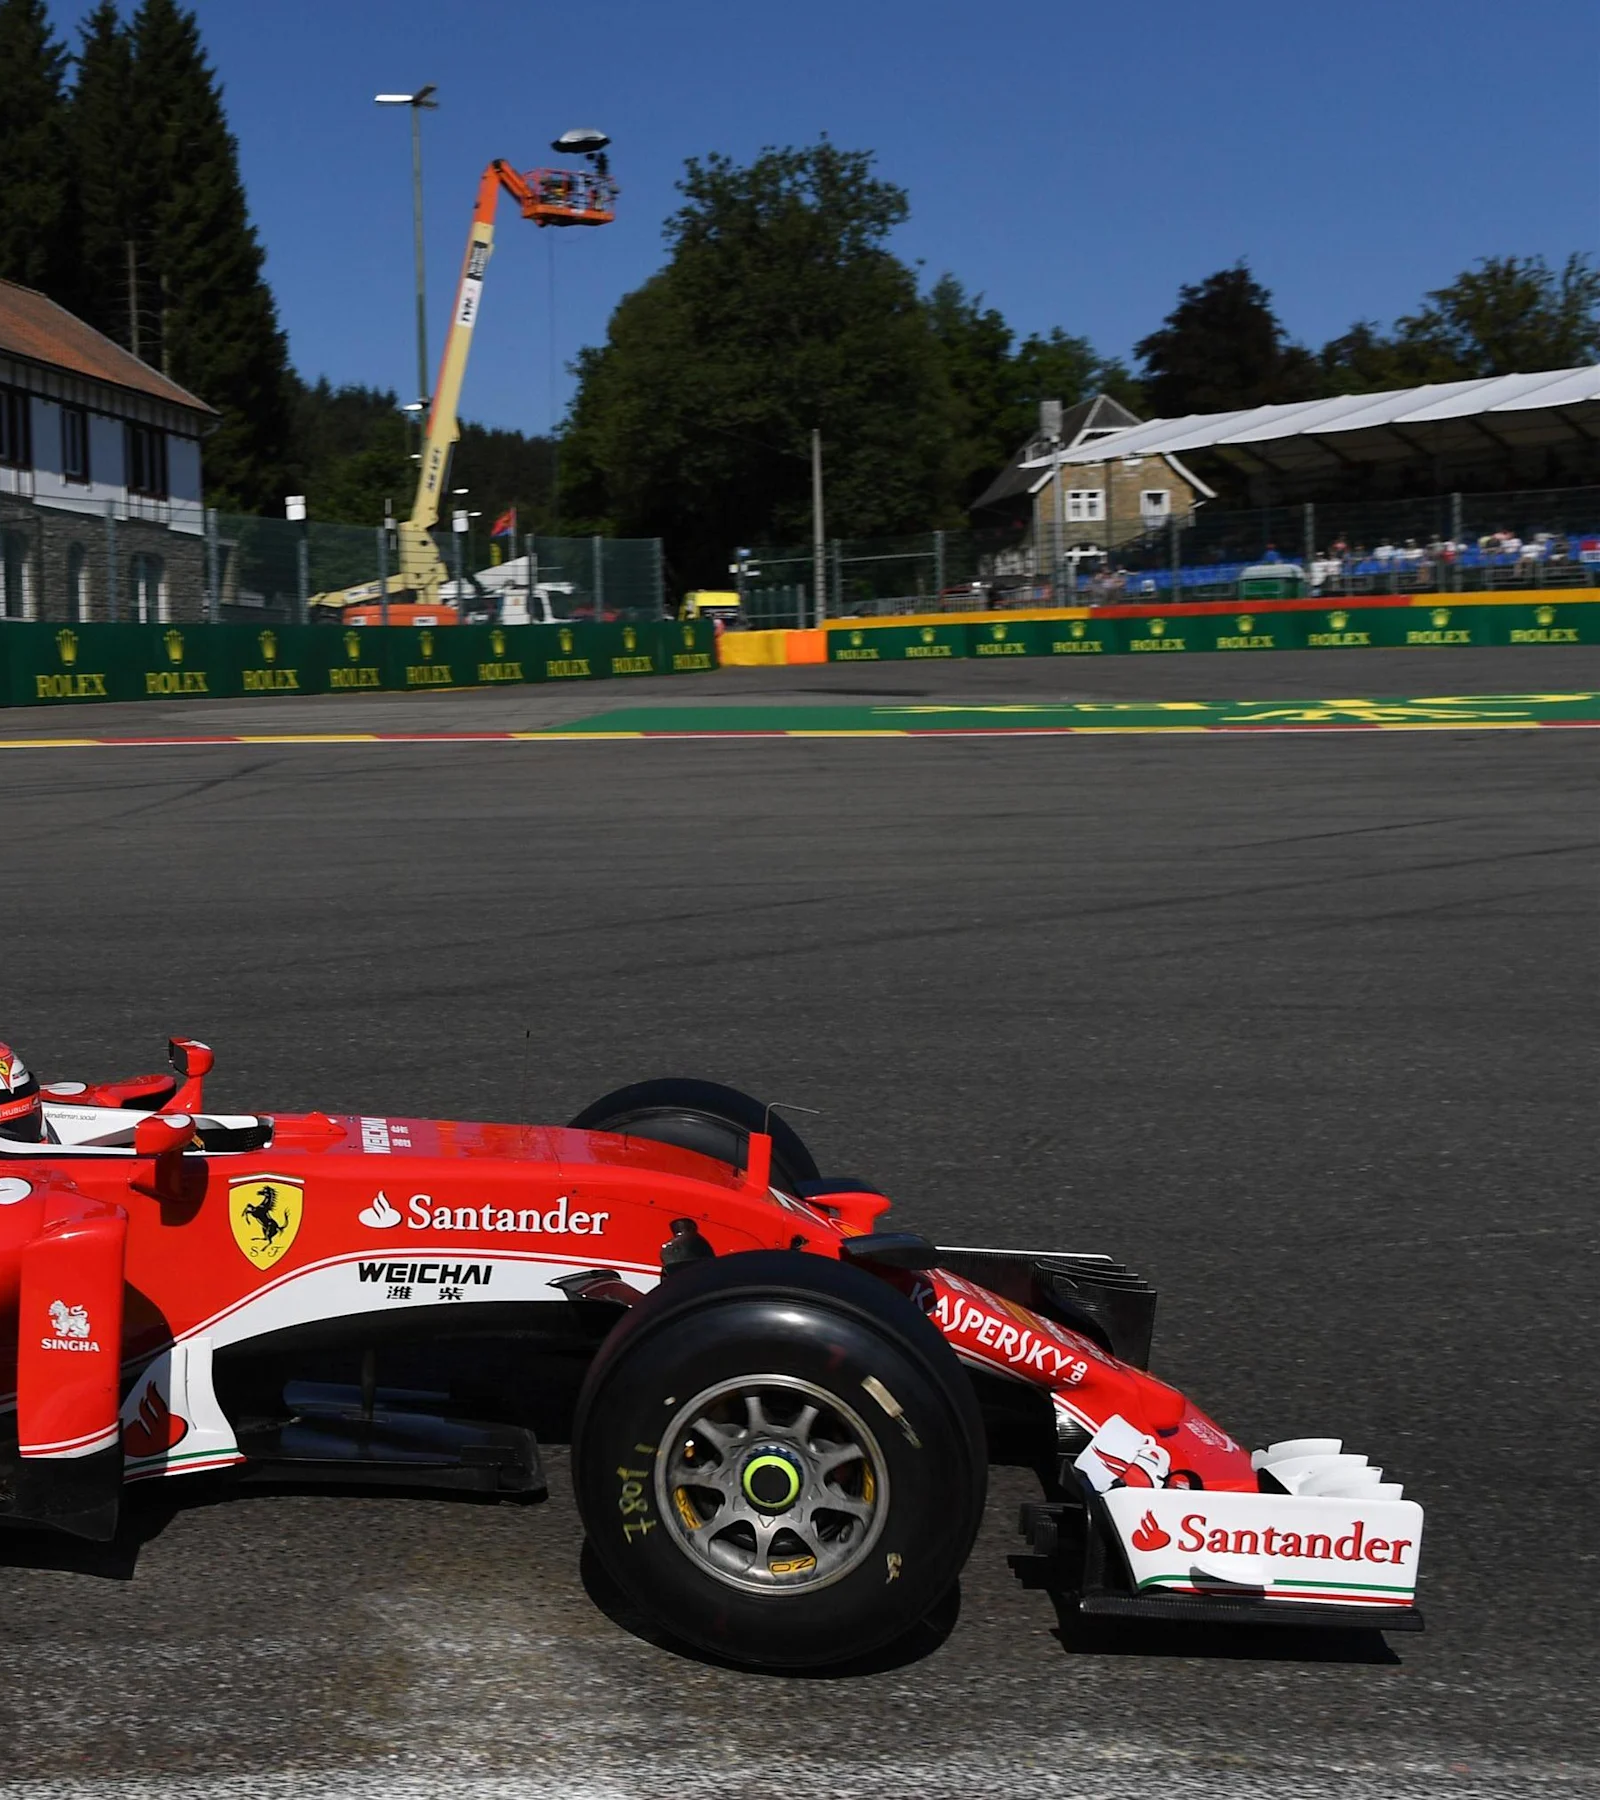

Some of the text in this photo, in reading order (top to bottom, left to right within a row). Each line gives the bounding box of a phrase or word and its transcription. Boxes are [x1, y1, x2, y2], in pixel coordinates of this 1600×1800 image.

[1217, 635, 1273, 649] ROLEX
[1309, 632, 1370, 646] ROLEX
[1408, 631, 1469, 644] ROLEX
[1511, 628, 1577, 642] ROLEX
[906, 645, 951, 660] ROLEX
[977, 643, 1025, 655] ROLEX
[1054, 641, 1102, 653] ROLEX
[1130, 639, 1184, 651] ROLEX
[673, 653, 711, 670] ROLEX
[837, 649, 879, 661] ROLEX
[479, 662, 524, 681] ROLEX
[547, 658, 591, 677] ROLEX
[612, 655, 653, 673] ROLEX
[145, 671, 208, 694] ROLEX
[243, 669, 299, 691] ROLEX
[329, 667, 380, 688] ROLEX
[407, 664, 453, 685] ROLEX
[36, 673, 107, 698] ROLEX
[2, 1104, 31, 1117] HUBLOT
[407, 1194, 610, 1236] Santander
[358, 1262, 492, 1285] WEICHAI
[41, 1338, 100, 1352] SINGHA
[1063, 1361, 1088, 1386] lab
[1178, 1513, 1412, 1566] Santander
